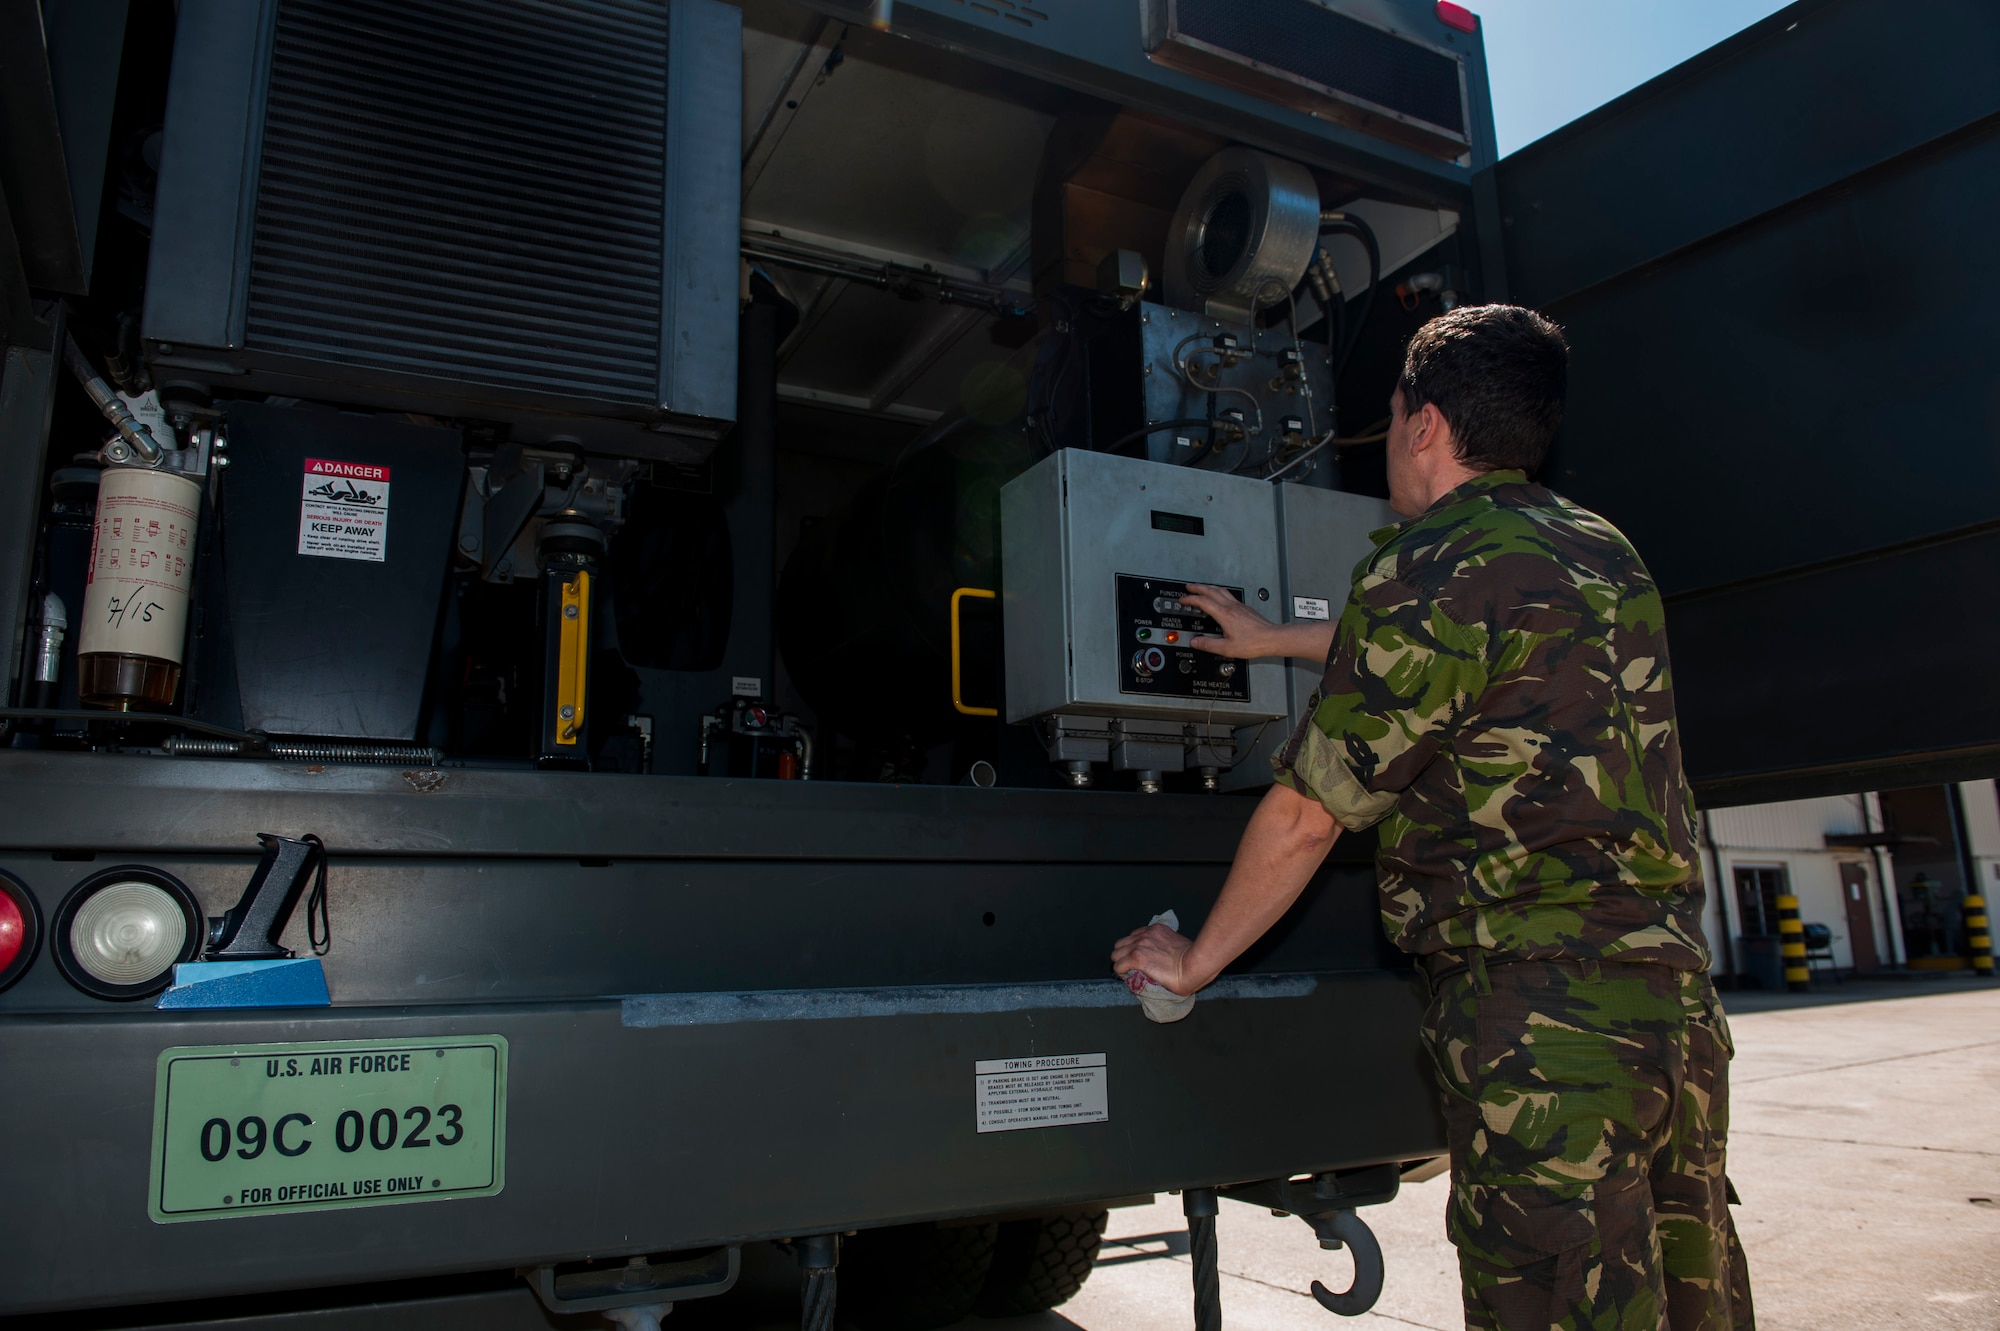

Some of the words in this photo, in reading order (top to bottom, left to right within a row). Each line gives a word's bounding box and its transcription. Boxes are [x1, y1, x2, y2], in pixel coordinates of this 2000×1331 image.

[325, 463, 382, 478] DANGER
[312, 523, 343, 533] KEEP
[344, 526, 375, 537] AWAY
[108, 585, 164, 629] 7/15
[1134, 618, 1152, 626] POWER
[1193, 688, 1199, 696] by
[1208, 681, 1230, 689] HEATER
[266, 1059, 303, 1078] U.S.
[310, 1057, 342, 1076] AIR
[350, 1054, 410, 1073] FORCE
[1005, 1061, 1032, 1070] TOWING
[1036, 1057, 1080, 1067] PROCEDURE
[200, 1113, 313, 1162] 09C
[335, 1104, 464, 1153] 0023
[241, 1188, 271, 1204] FOR
[277, 1183, 348, 1201] OFFICIAL
[354, 1181, 382, 1197] USE
[387, 1176, 423, 1193] ONLY
